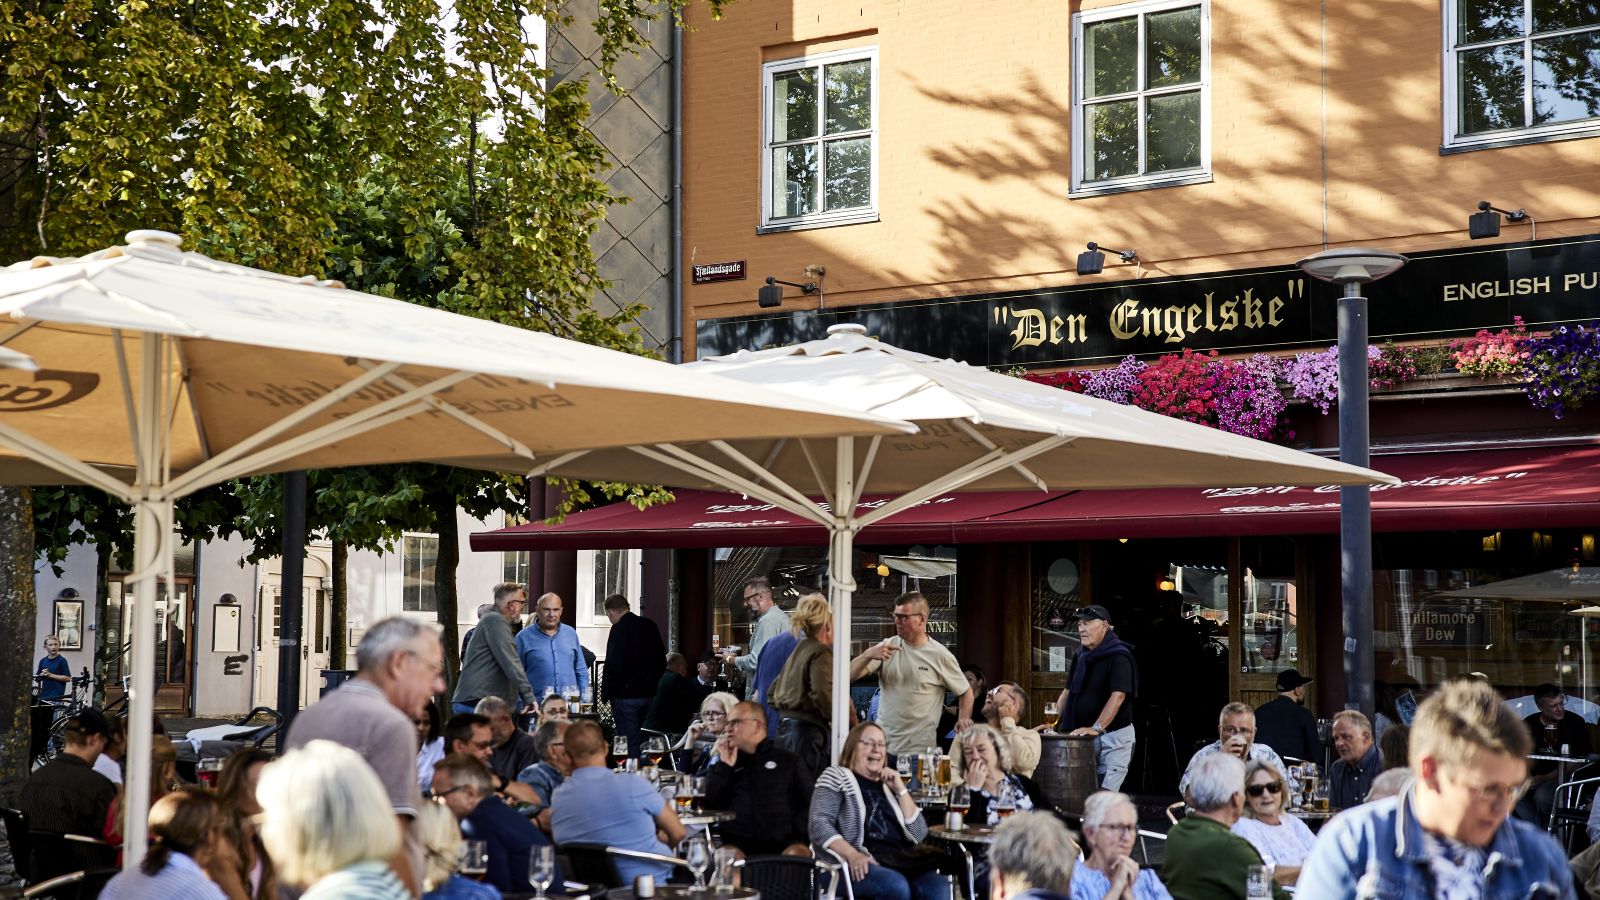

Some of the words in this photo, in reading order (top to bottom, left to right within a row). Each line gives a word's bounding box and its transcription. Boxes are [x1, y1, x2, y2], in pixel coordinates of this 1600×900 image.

[695, 263, 741, 278] Sjællandsgade
[1443, 276, 1550, 302] ENGLISH
[1563, 271, 1600, 292] PU
[993, 306, 1088, 350] "Den
[1109, 278, 1304, 343] Engelske"
[1425, 627, 1456, 641] Dew
